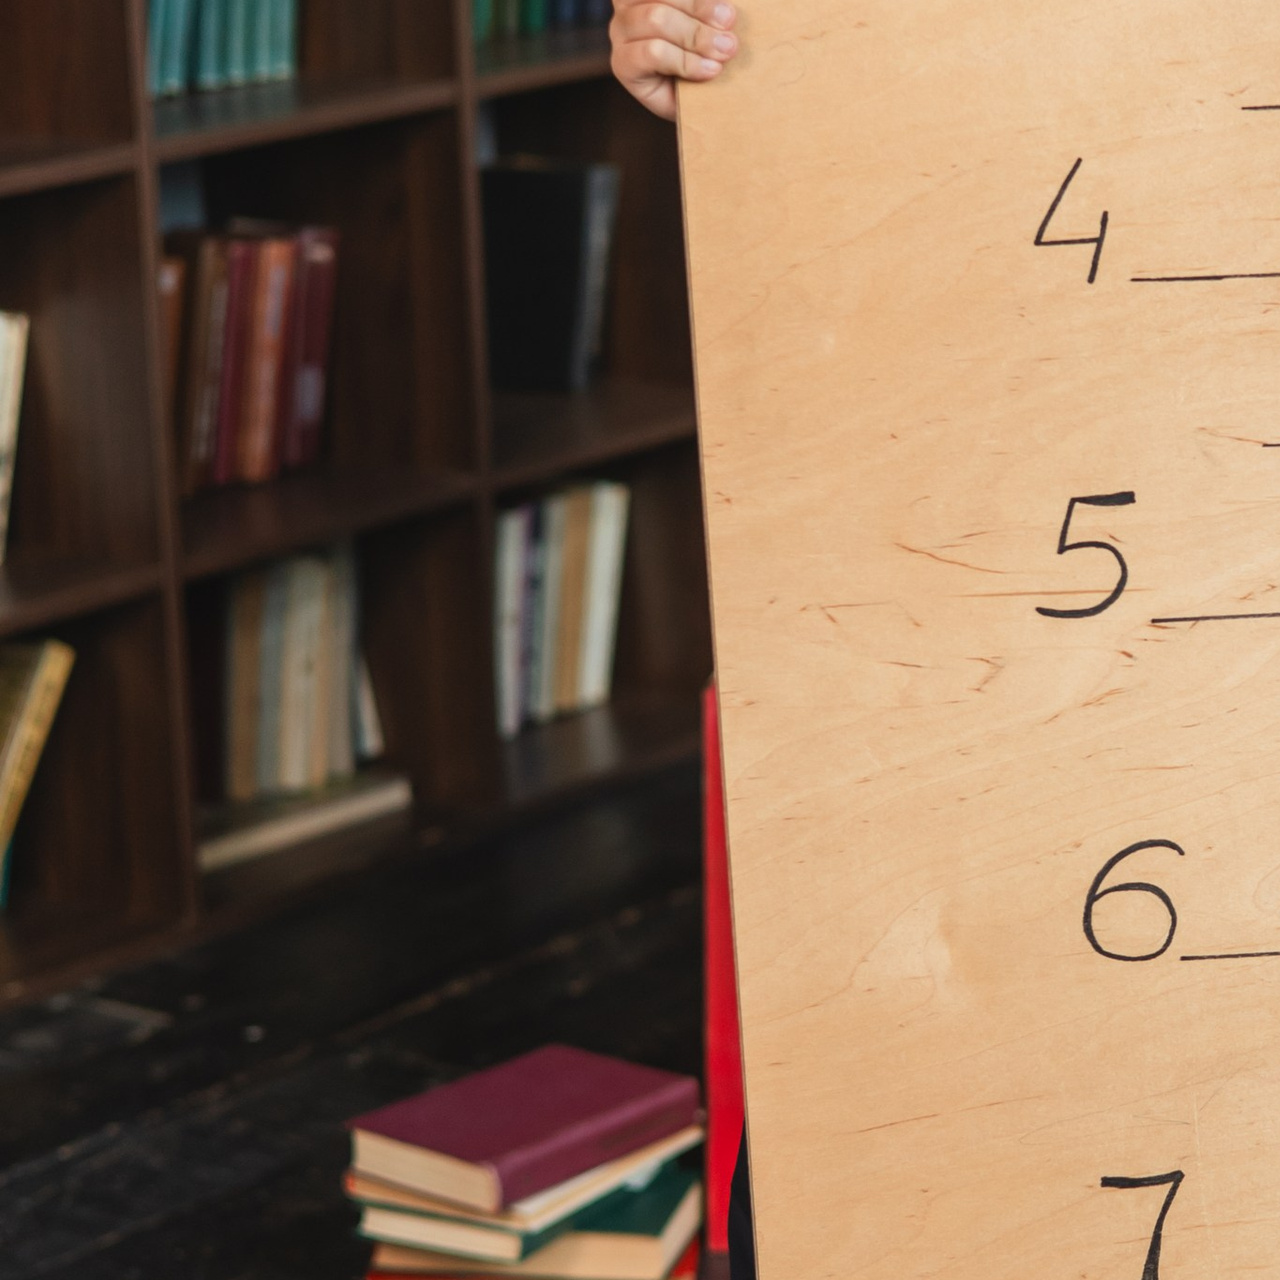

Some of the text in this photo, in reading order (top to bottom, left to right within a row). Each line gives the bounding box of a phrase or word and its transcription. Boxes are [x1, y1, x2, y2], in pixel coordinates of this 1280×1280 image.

[1033, 157, 1109, 285] 4
[1035, 491, 1136, 619] 5
[1082, 839, 1185, 962] 6
